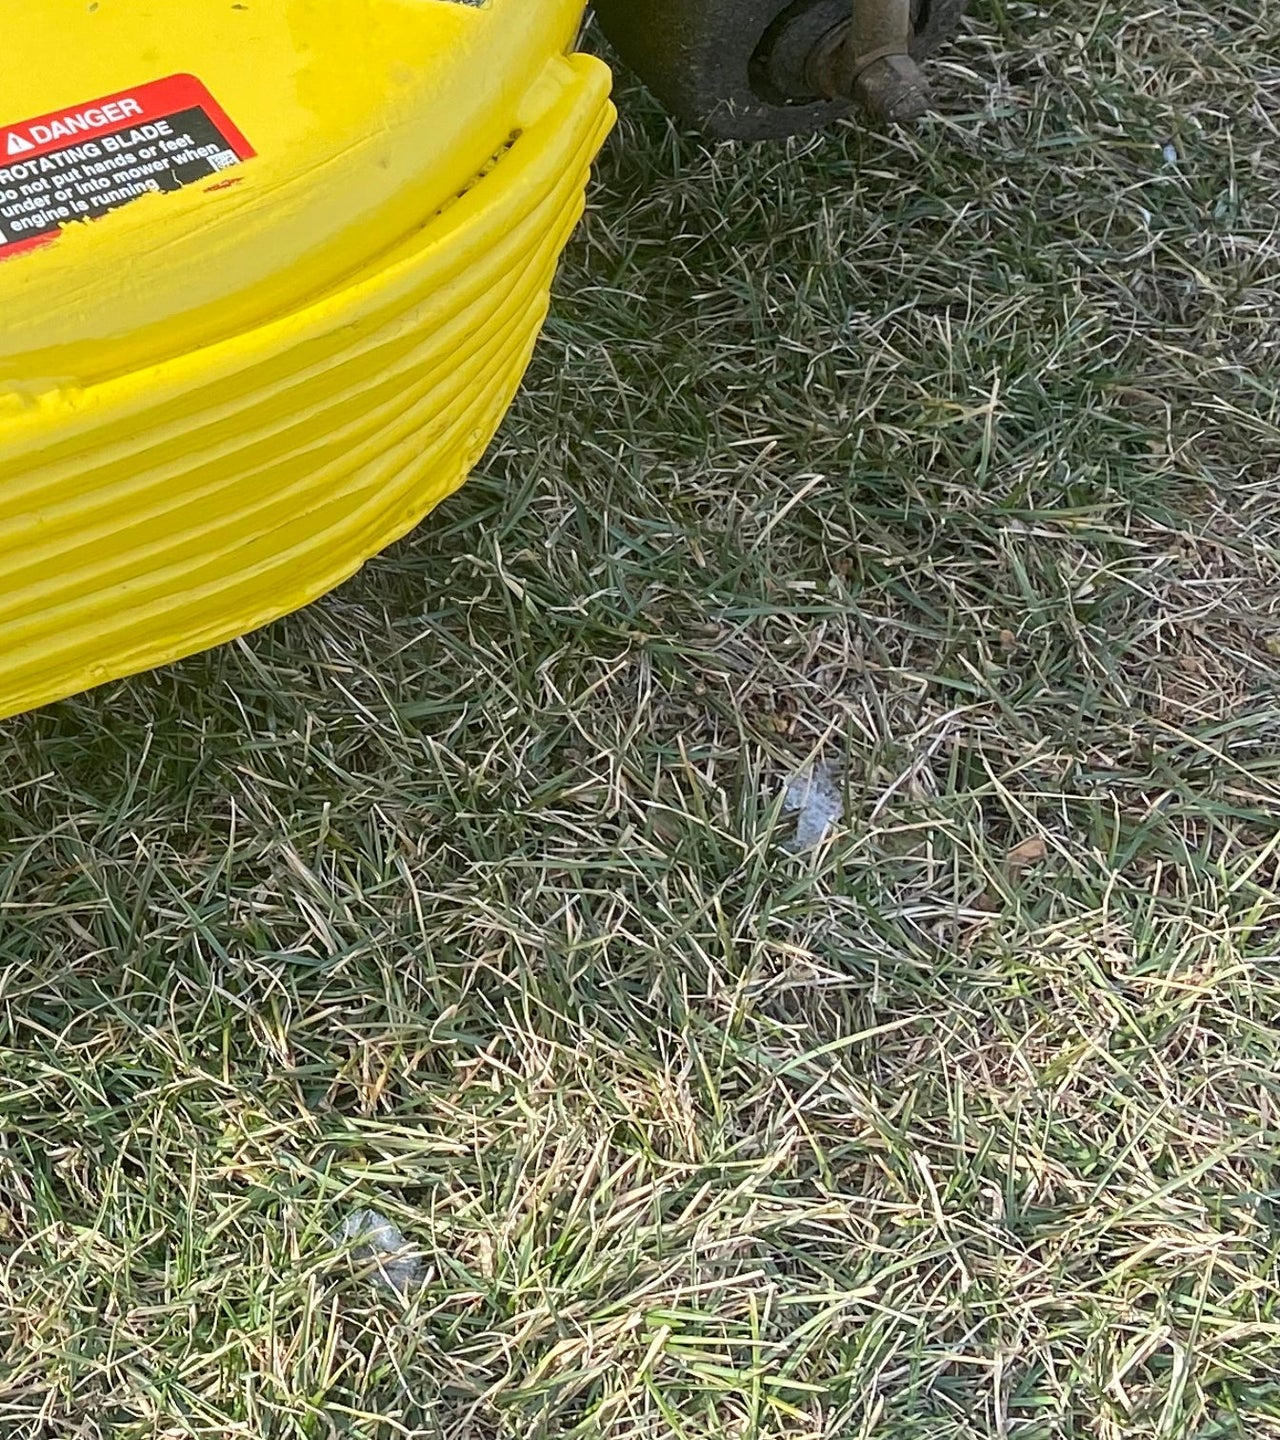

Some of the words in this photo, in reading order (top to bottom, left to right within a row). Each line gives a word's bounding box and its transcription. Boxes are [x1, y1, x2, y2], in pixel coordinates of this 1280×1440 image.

[29, 98, 143, 144] DANGER
[102, 121, 173, 152] BLADE
[1, 197, 51, 219] under
[54, 187, 72, 202] or
[76, 178, 110, 195] into
[113, 158, 170, 184] mower
[174, 144, 219, 165] when
[20, 176, 52, 197] not
[52, 169, 81, 192] put
[83, 153, 135, 178] hands
[138, 147, 155, 159] or
[160, 133, 195, 151] feet
[10, 206, 70, 232] engine
[73, 199, 88, 212] is
[92, 178, 160, 206] running
